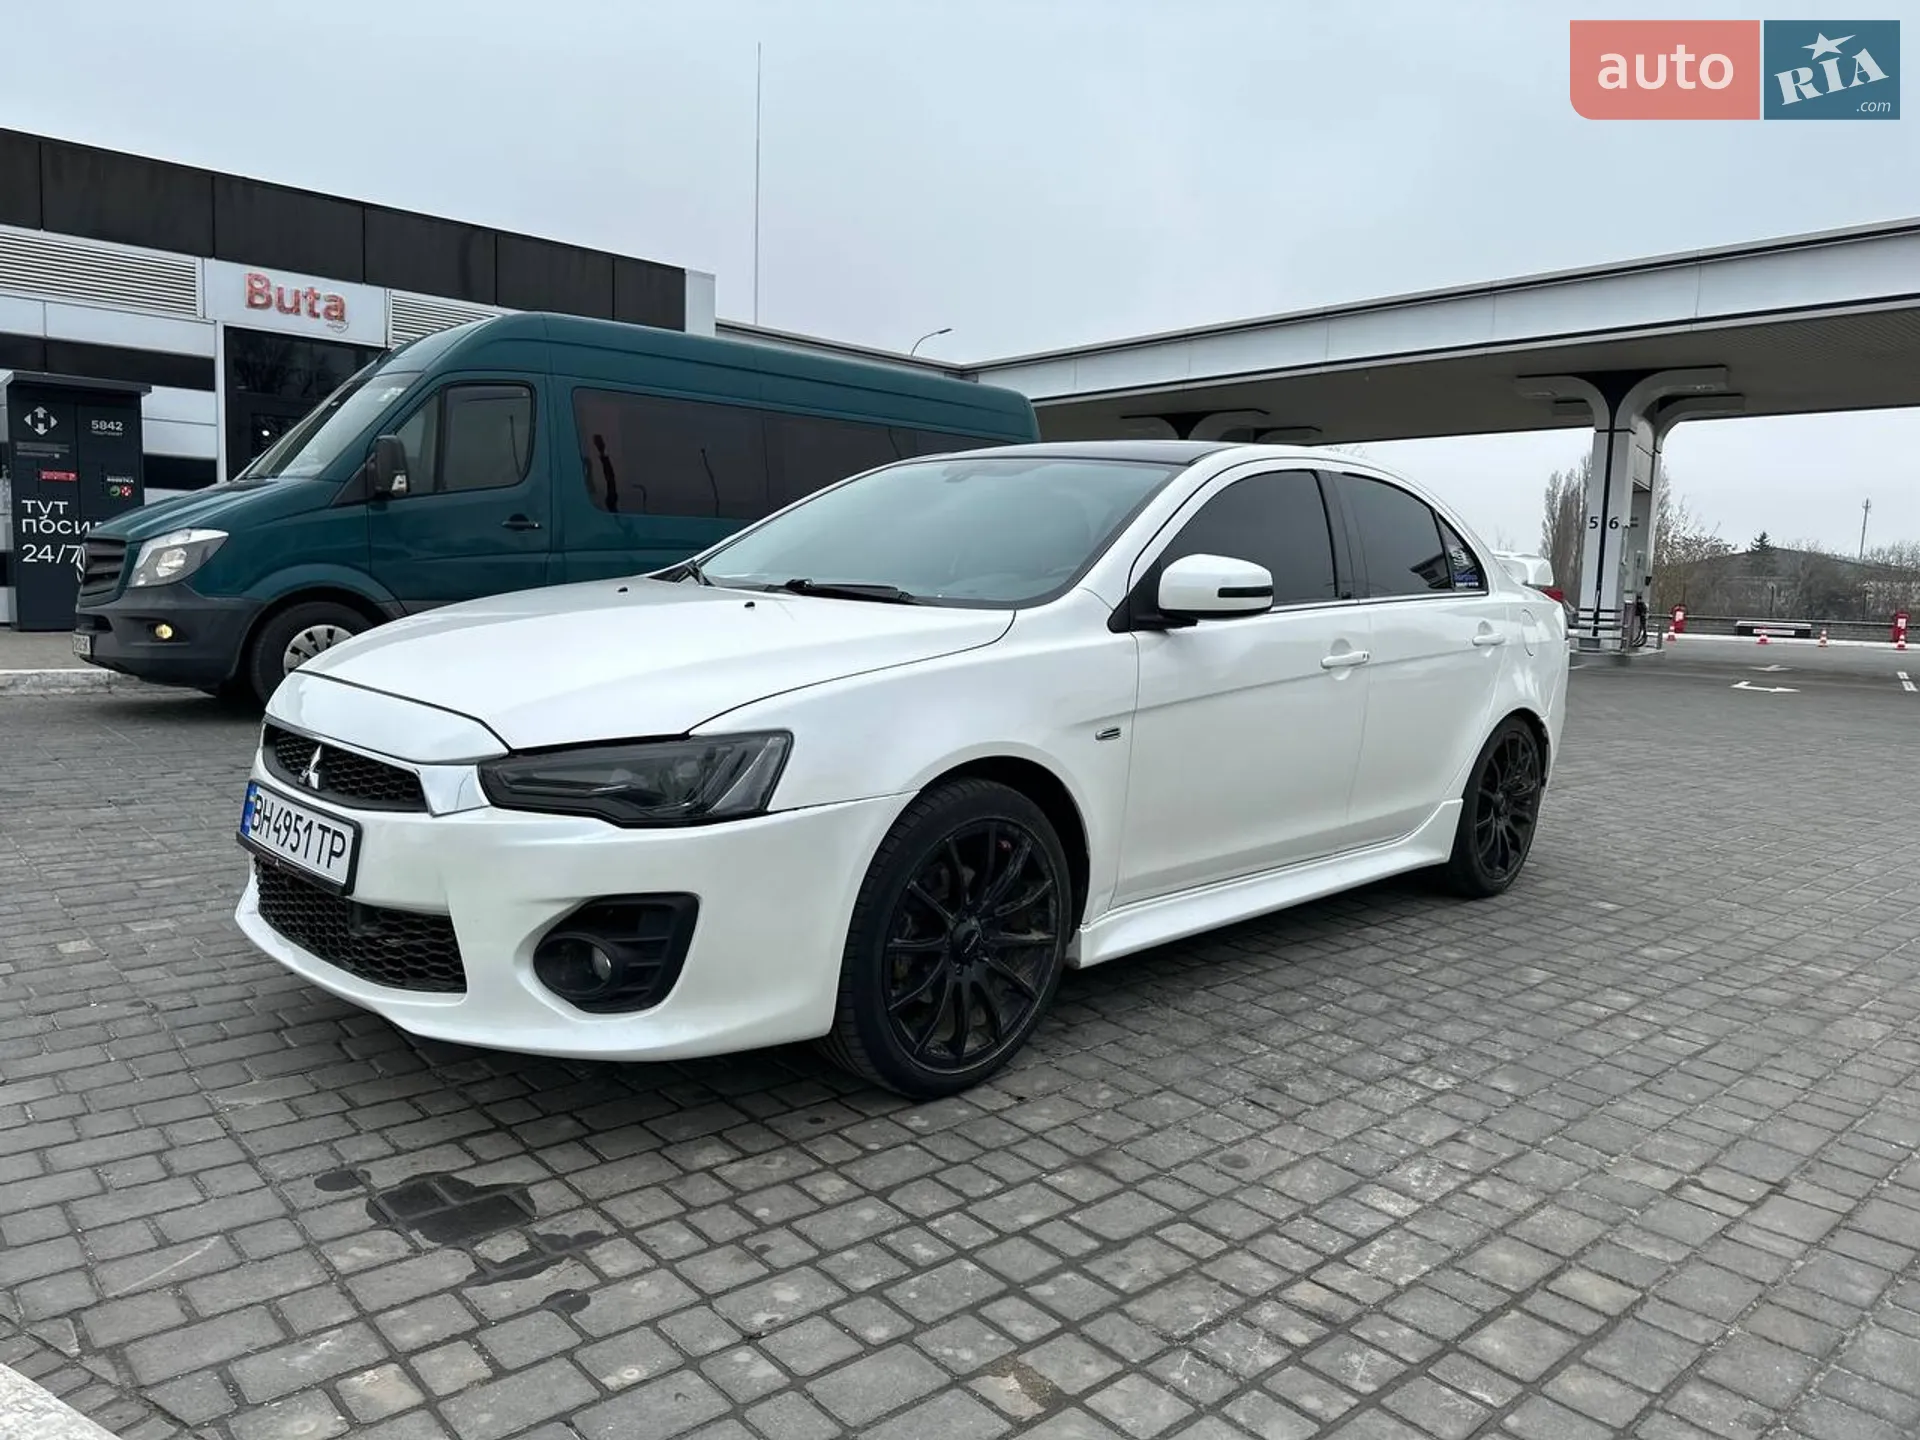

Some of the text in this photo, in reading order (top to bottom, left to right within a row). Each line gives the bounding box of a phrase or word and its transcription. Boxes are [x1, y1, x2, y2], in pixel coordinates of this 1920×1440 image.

[244, 272, 346, 322] Buta
[91, 420, 123, 431] 5842
[1589, 516, 1619, 529] 5 6
[22, 544, 81, 564] 24/7
